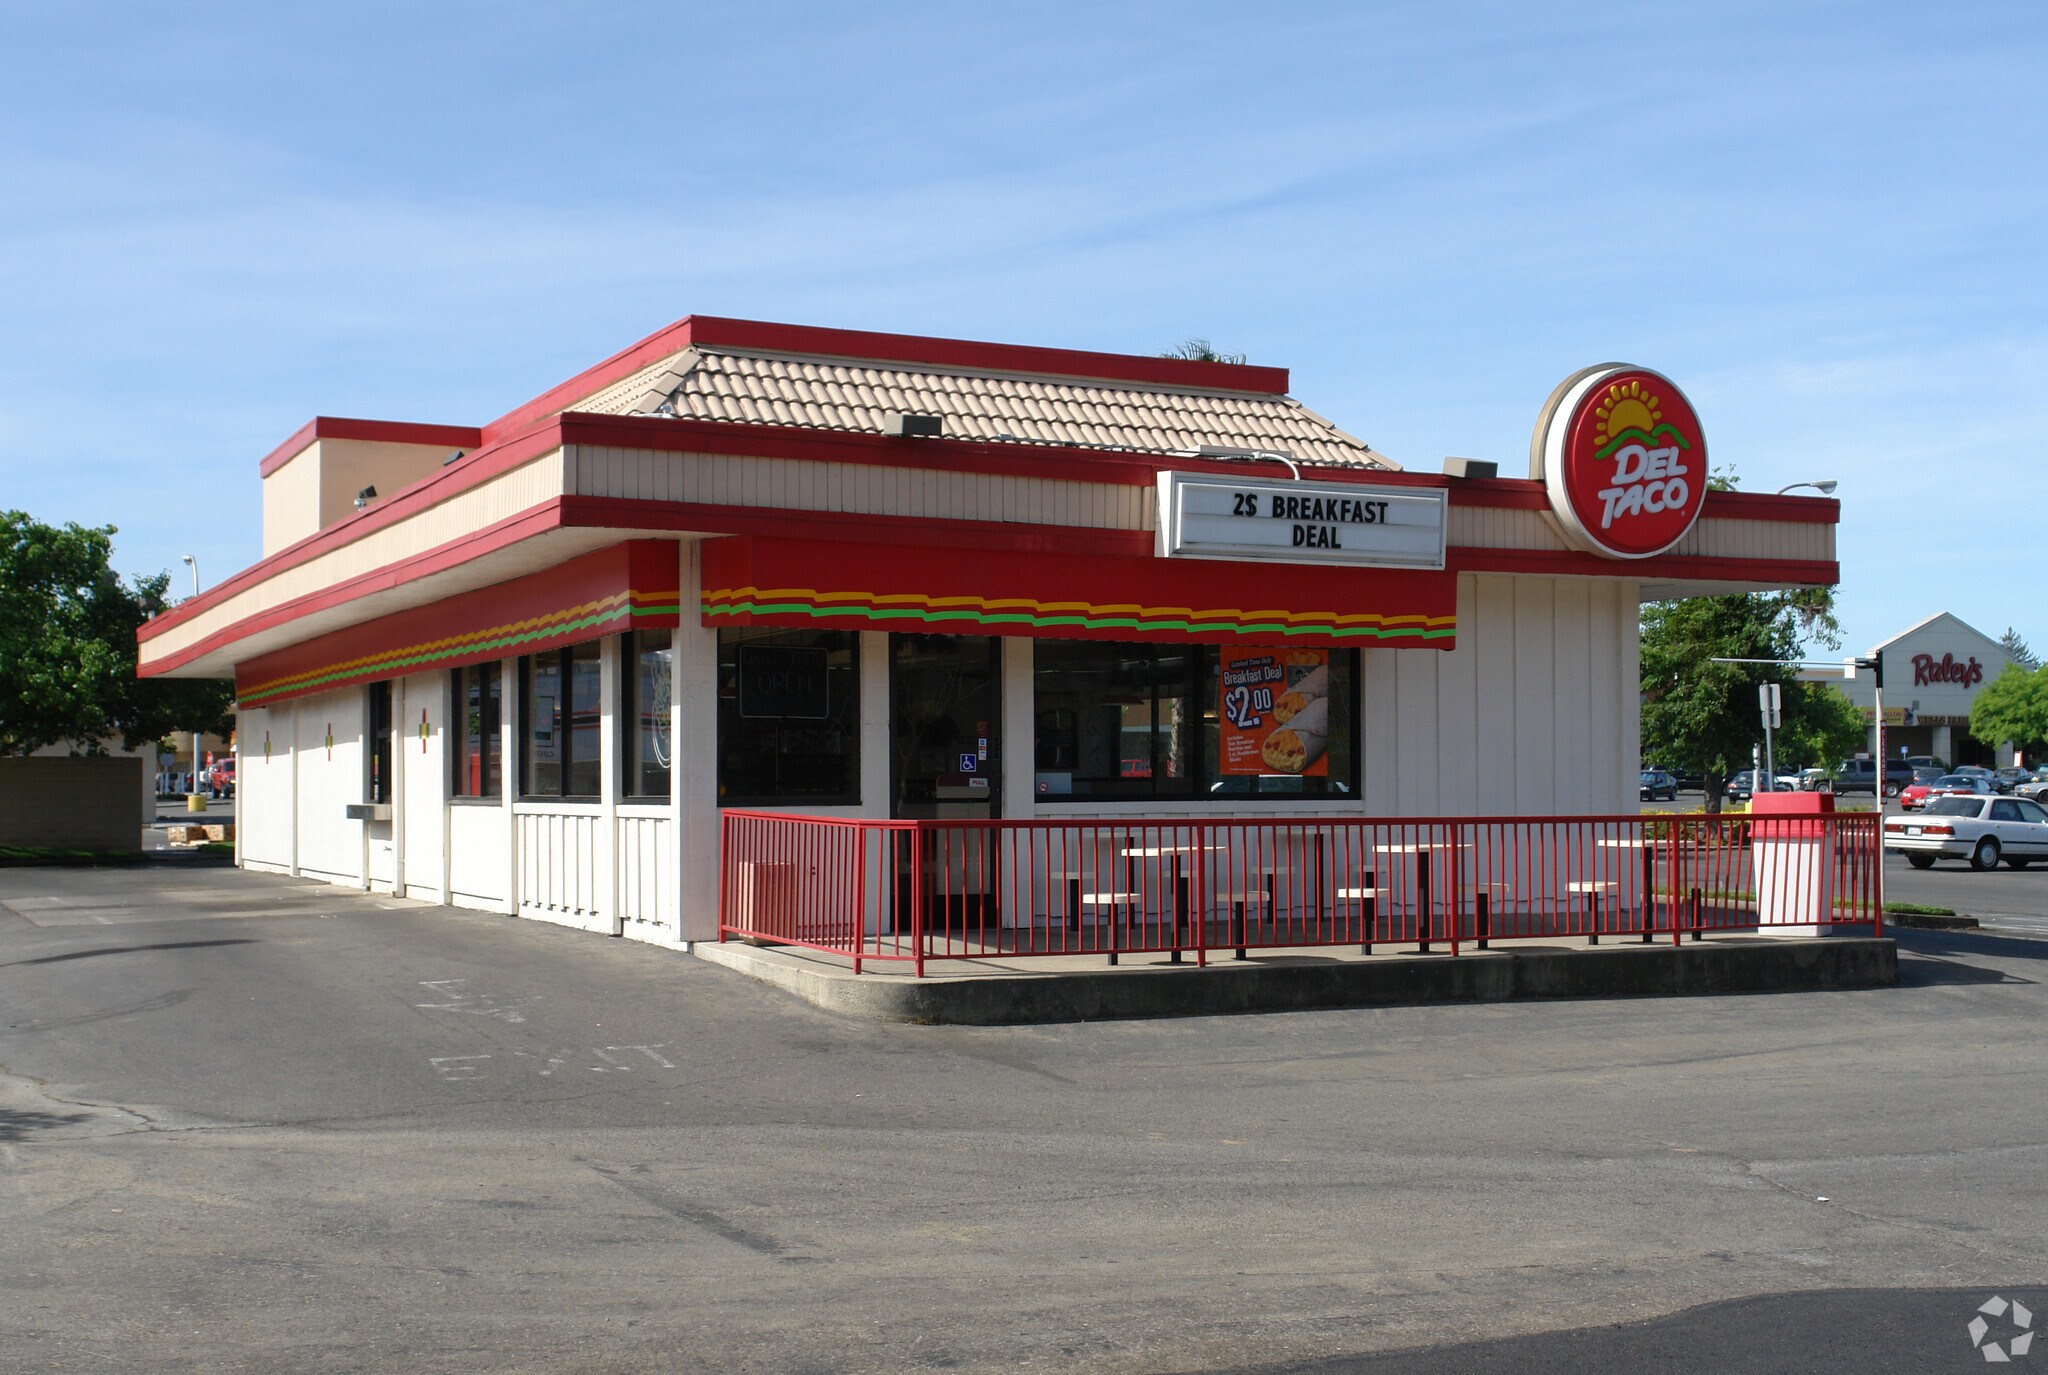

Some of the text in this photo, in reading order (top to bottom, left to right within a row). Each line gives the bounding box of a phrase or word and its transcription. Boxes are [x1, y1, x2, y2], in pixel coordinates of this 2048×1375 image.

[1611, 444, 1688, 485] DEL
[1272, 495, 1389, 524] BREAKFAST
[1598, 477, 1689, 529] TACO
[1292, 524, 1342, 549] DEAL
[1224, 669, 1262, 685] Breakfast
[1264, 664, 1283, 681] Deal
[1911, 652, 1983, 689] Raley's
